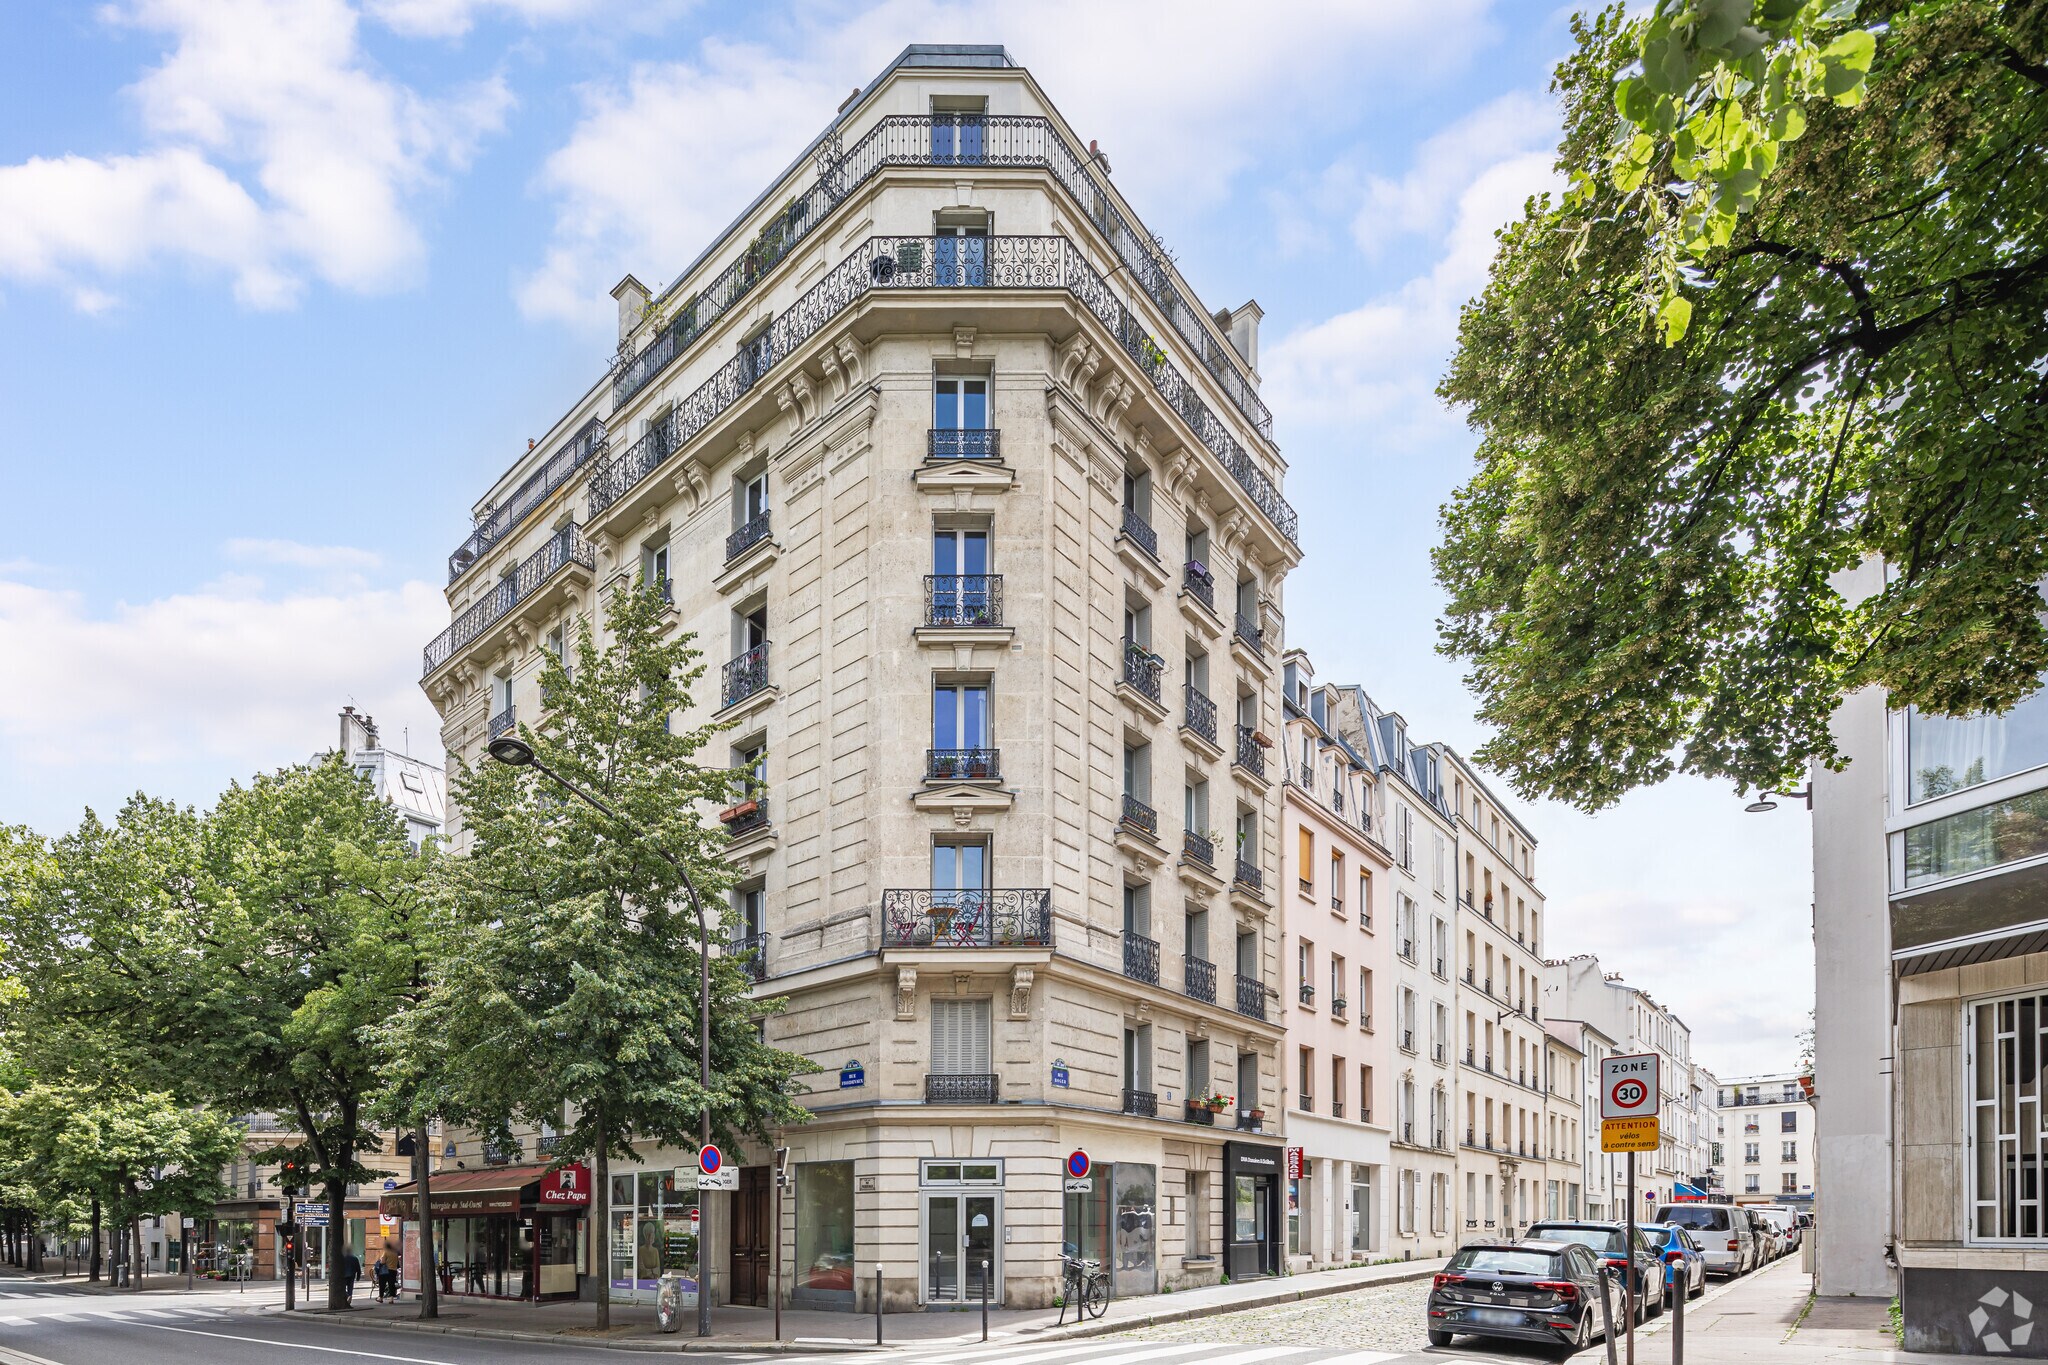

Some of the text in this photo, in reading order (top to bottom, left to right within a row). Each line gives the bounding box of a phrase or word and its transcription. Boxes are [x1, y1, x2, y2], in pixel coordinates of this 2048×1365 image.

[1611, 1062, 1648, 1074] ZONE
[1618, 1086, 1641, 1101] 30
[1604, 1121, 1656, 1131] ATTENTION
[1619, 1132, 1640, 1140] vélos
[1603, 1140, 1655, 1149] à contre sens
[1288, 1147, 1300, 1179] MASSAGE
[545, 1190, 587, 1201] Chez Papa
